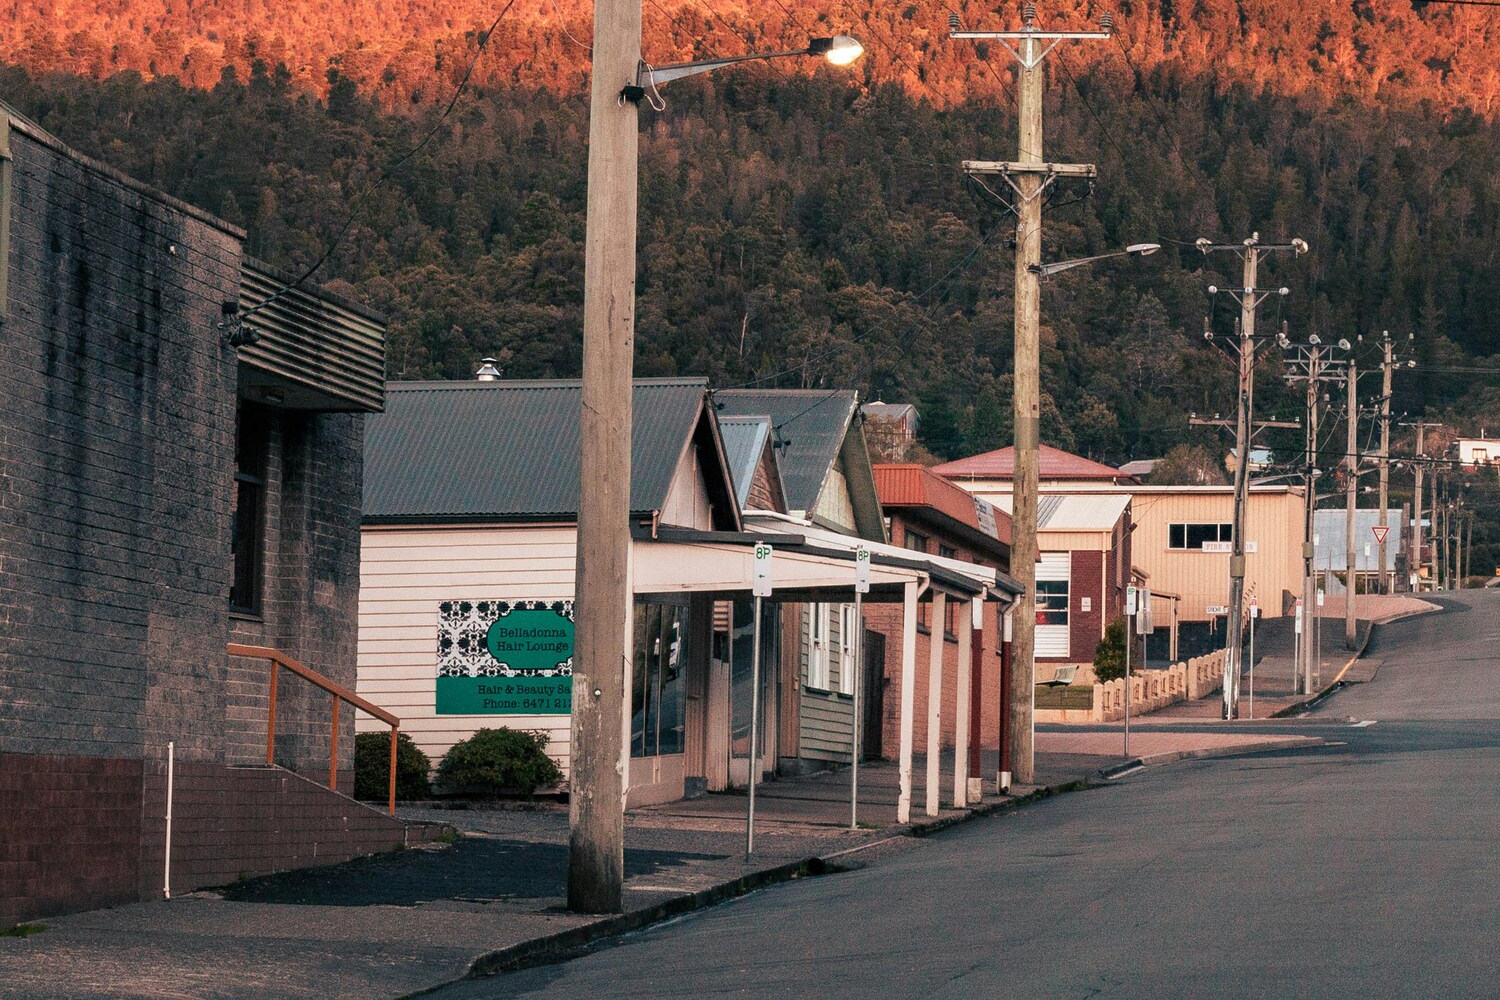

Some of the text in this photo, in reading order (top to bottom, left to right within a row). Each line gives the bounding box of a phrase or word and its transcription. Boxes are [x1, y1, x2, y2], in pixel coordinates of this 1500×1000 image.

[755, 546, 771, 560] 8P
[857, 549, 869, 562] 8P
[500, 628, 567, 638] Belladonna
[497, 641, 569, 653] Hair Lounge
[477, 684, 571, 696] Hair & Beauty Sa
[482, 698, 572, 709] Phone: 6471 21
